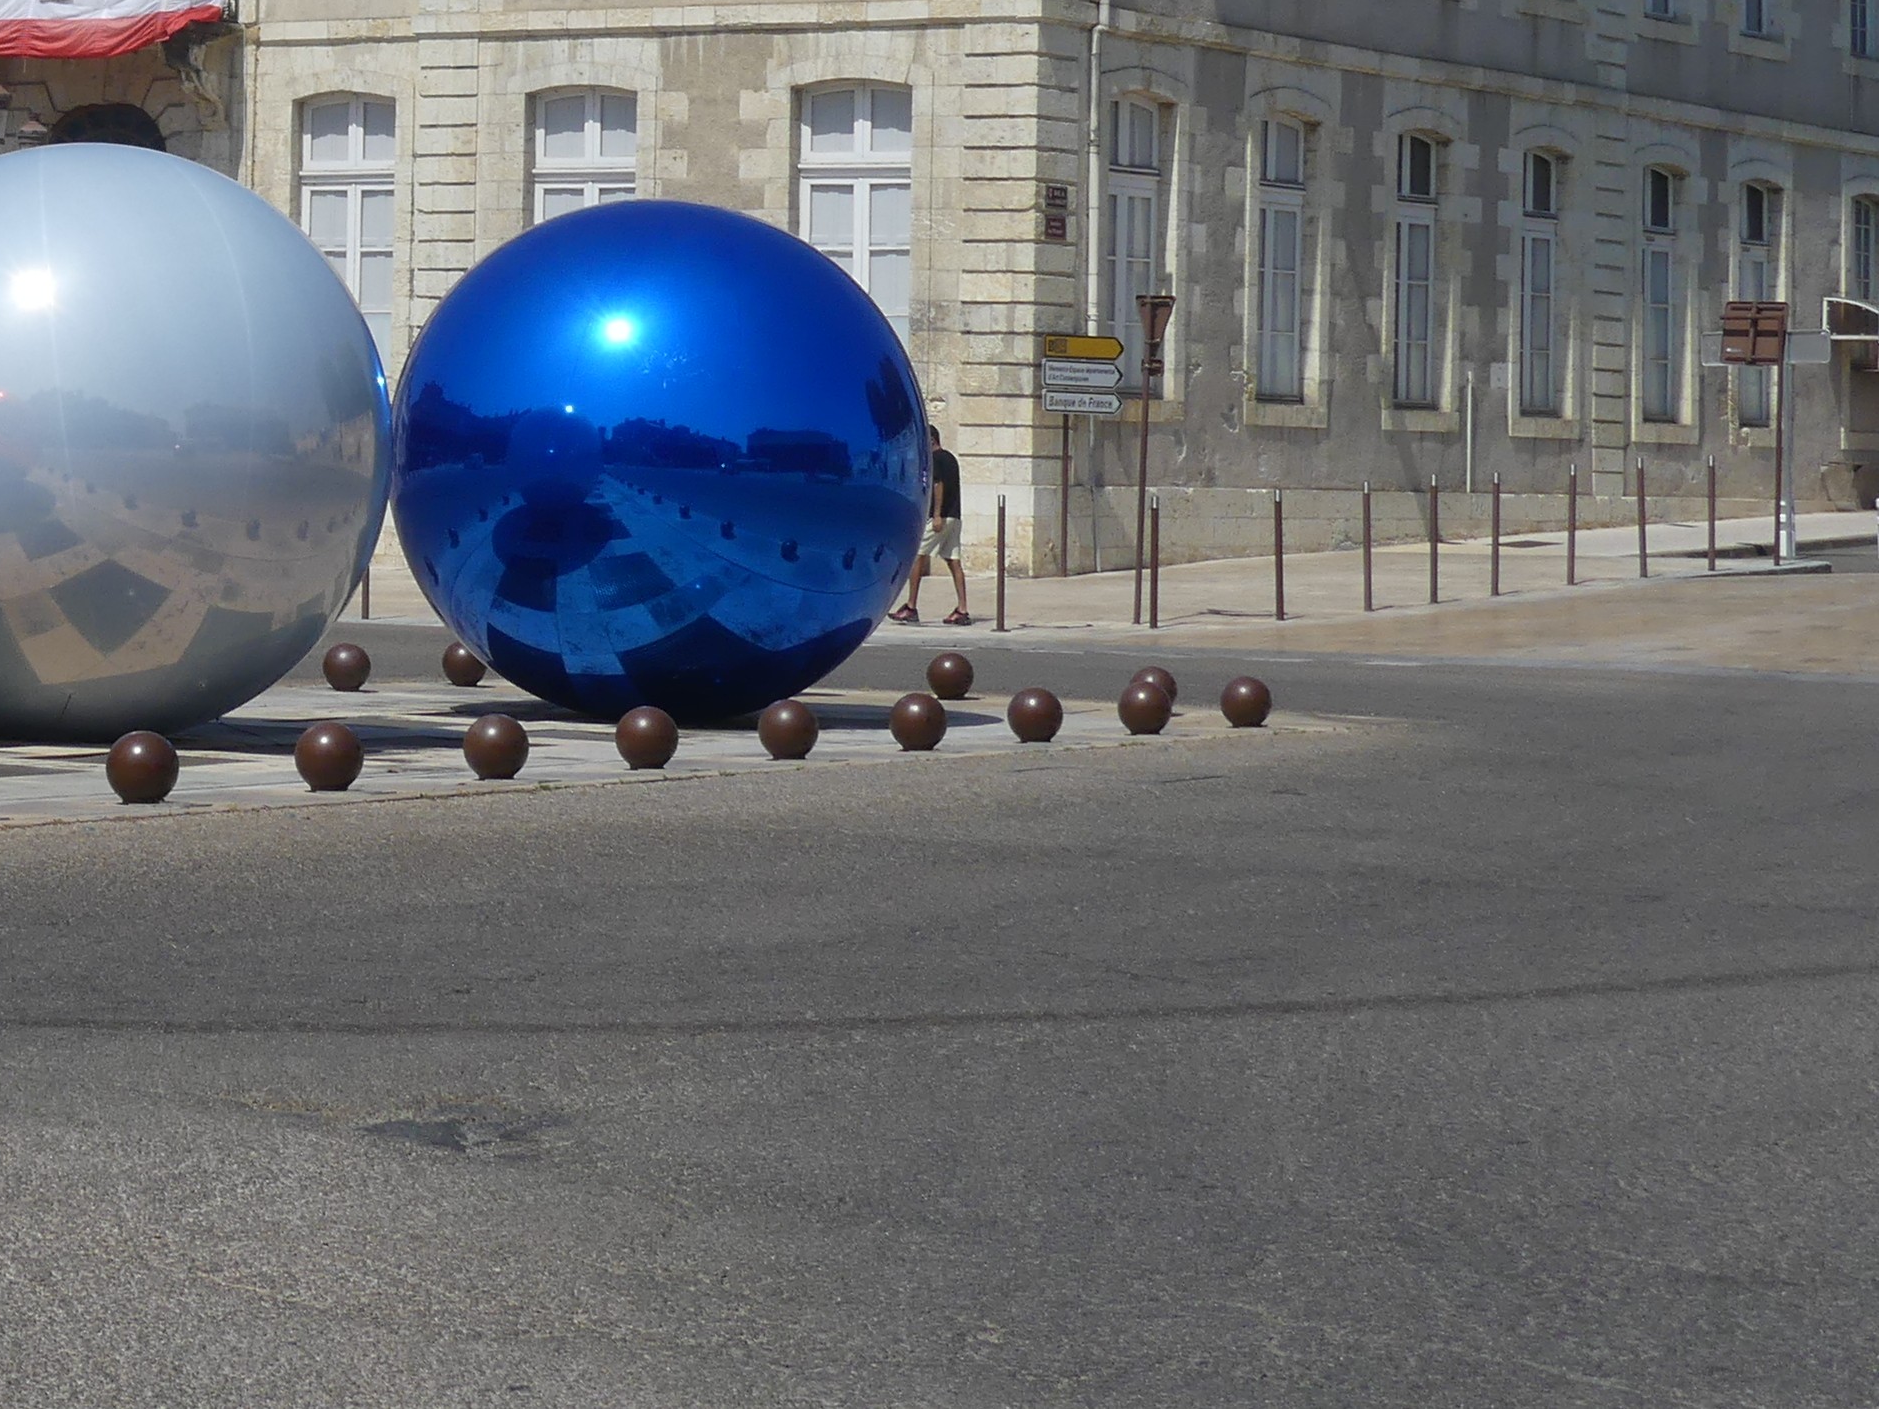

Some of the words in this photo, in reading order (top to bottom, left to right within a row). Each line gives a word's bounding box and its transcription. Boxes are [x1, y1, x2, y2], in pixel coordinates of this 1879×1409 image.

[1048, 395, 1076, 409] Banque
[1077, 397, 1086, 407] de
[1088, 397, 1113, 408] France
